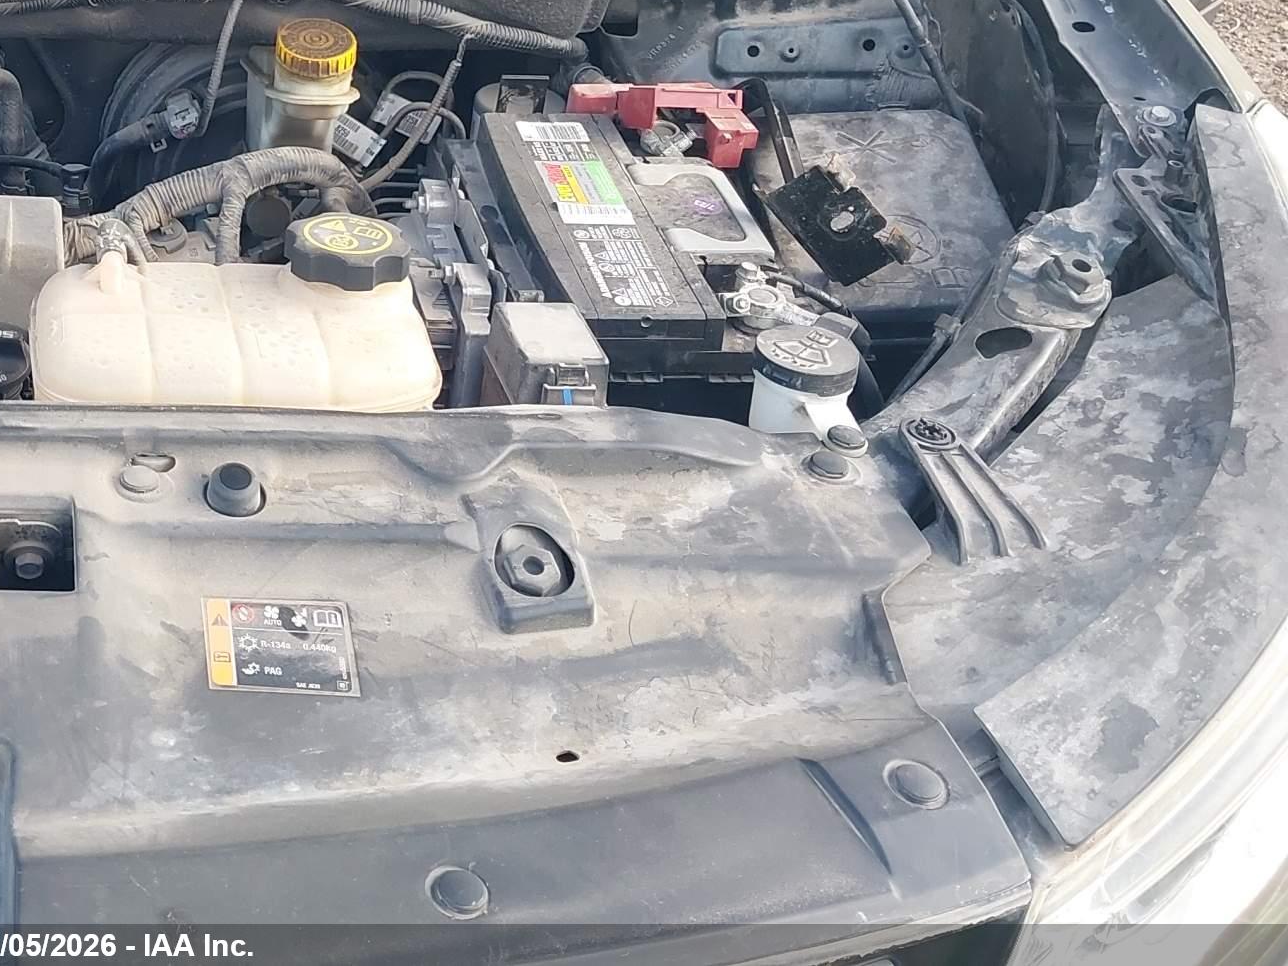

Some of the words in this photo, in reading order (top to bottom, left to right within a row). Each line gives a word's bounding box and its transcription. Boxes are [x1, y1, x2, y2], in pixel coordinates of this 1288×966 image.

[261, 641, 291, 649] R-134a
[302, 643, 337, 653] 0.440kg
[264, 666, 283, 676] PAG
